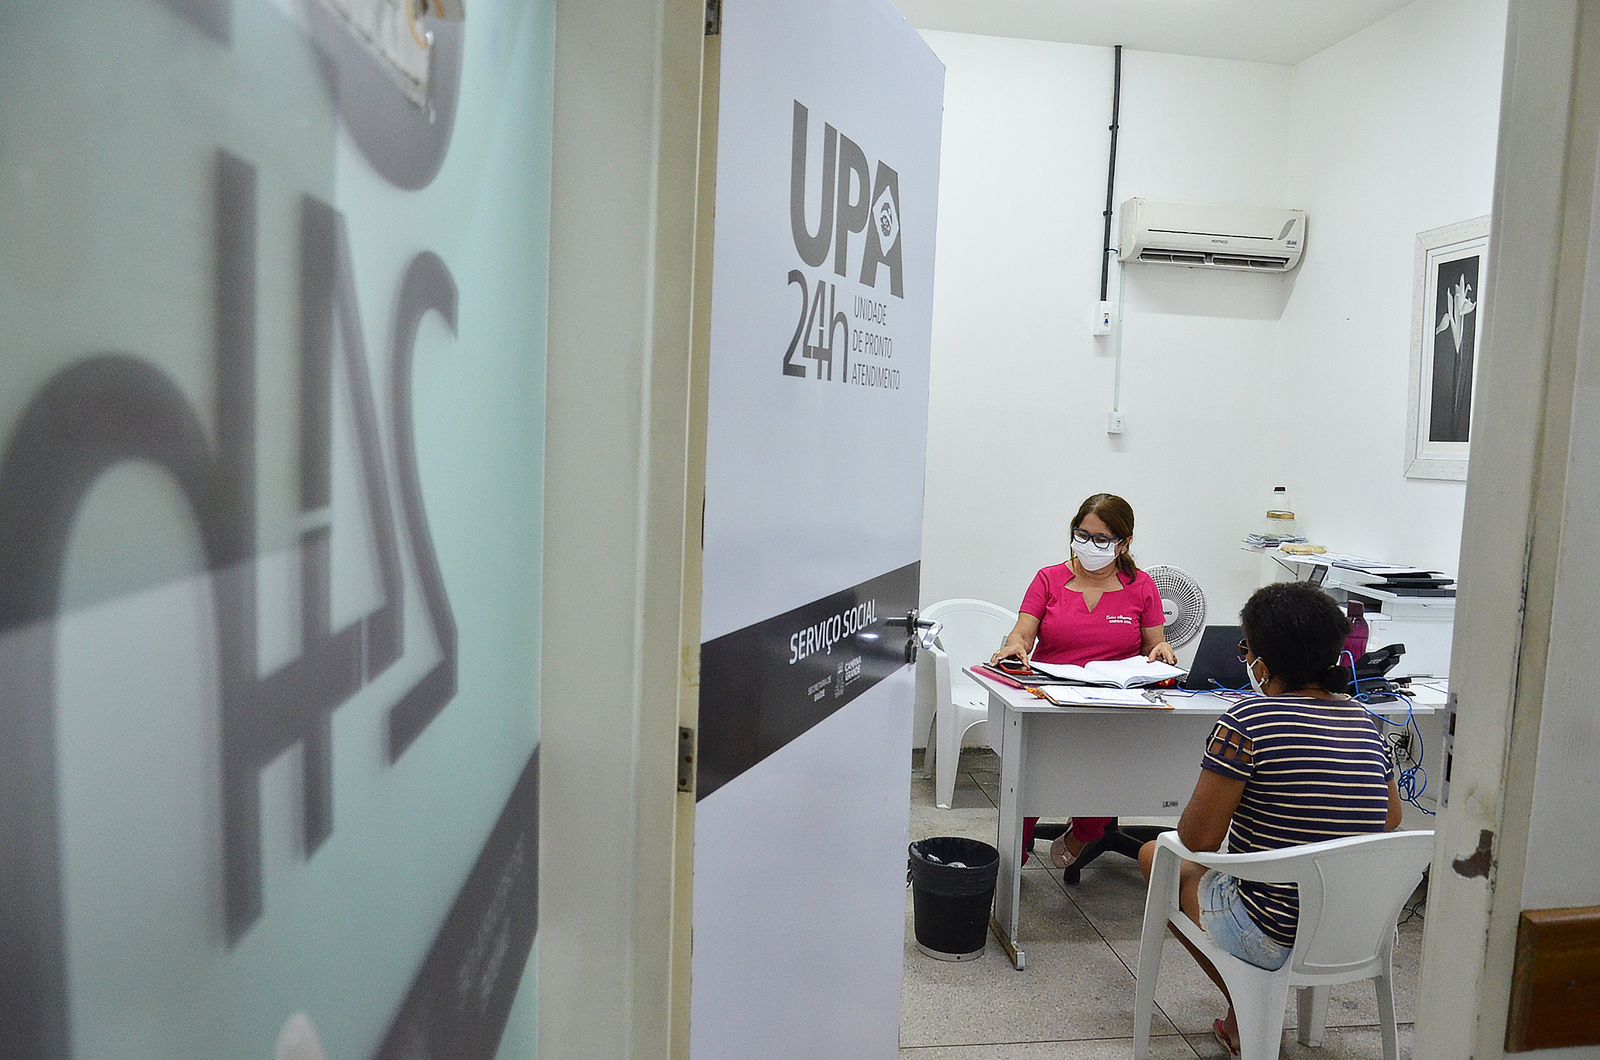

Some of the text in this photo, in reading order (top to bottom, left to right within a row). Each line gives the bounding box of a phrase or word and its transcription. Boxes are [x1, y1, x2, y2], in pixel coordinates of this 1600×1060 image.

[791, 99, 904, 299] UPA
[783, 269, 849, 383] 24h
[854, 295, 887, 326] UNIDADE
[852, 329, 893, 359] DE PRONTO
[851, 363, 901, 391] ATENDIMENTO
[789, 599, 877, 665] SERVIÇO SOCIAL
